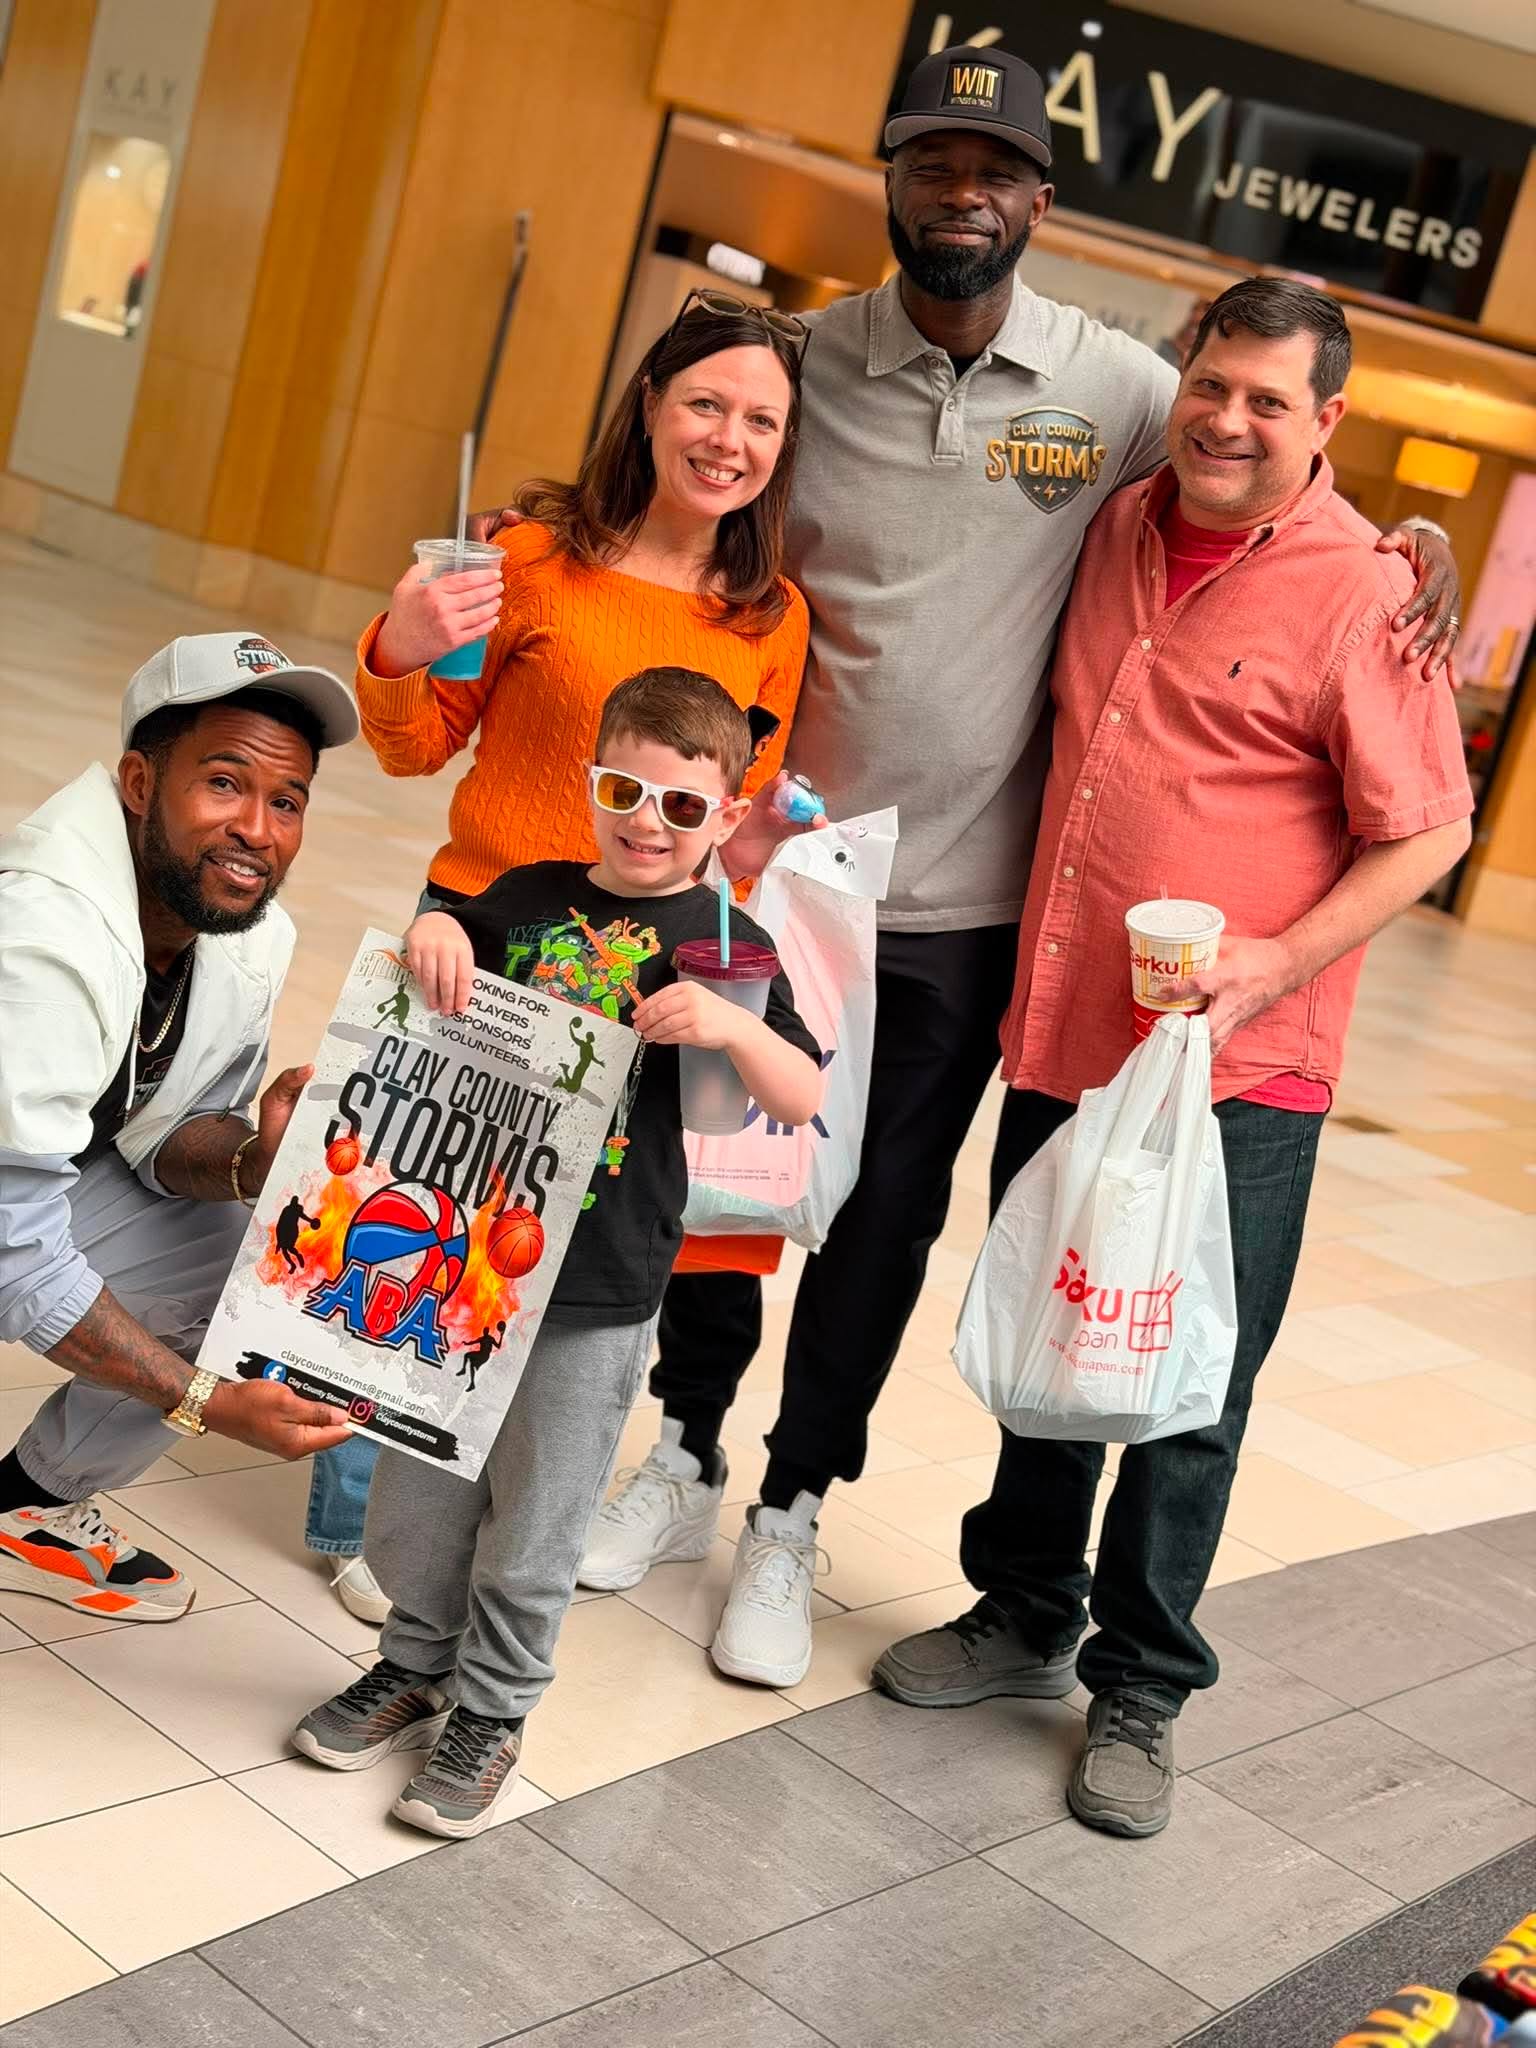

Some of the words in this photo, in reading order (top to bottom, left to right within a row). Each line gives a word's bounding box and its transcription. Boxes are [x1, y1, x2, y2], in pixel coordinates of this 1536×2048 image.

[104, 70, 179, 107] KAY
[953, 67, 999, 98] WIT
[1213, 162, 1482, 269] JEWELERS
[1013, 423, 1043, 437] CLAY
[1046, 423, 1092, 442] COUNTY
[985, 438, 1108, 487] STORMS
[467, 997, 530, 1029] PLAYERS
[472, 979, 516, 1004] OKING
[518, 996, 551, 1017] FOR:
[371, 1035, 449, 1097] CLAY
[448, 1065, 562, 1142] COUNTY
[324, 1072, 559, 1219] STORMS
[300, 1259, 449, 1368] ABA
[280, 1349, 426, 1417] claycountystorms@gmail.com
[287, 1376, 303, 1389] Clay
[302, 1382, 326, 1400] County
[325, 1391, 350, 1408] Storms
[375, 1412, 438, 1445] Claycountystorms
